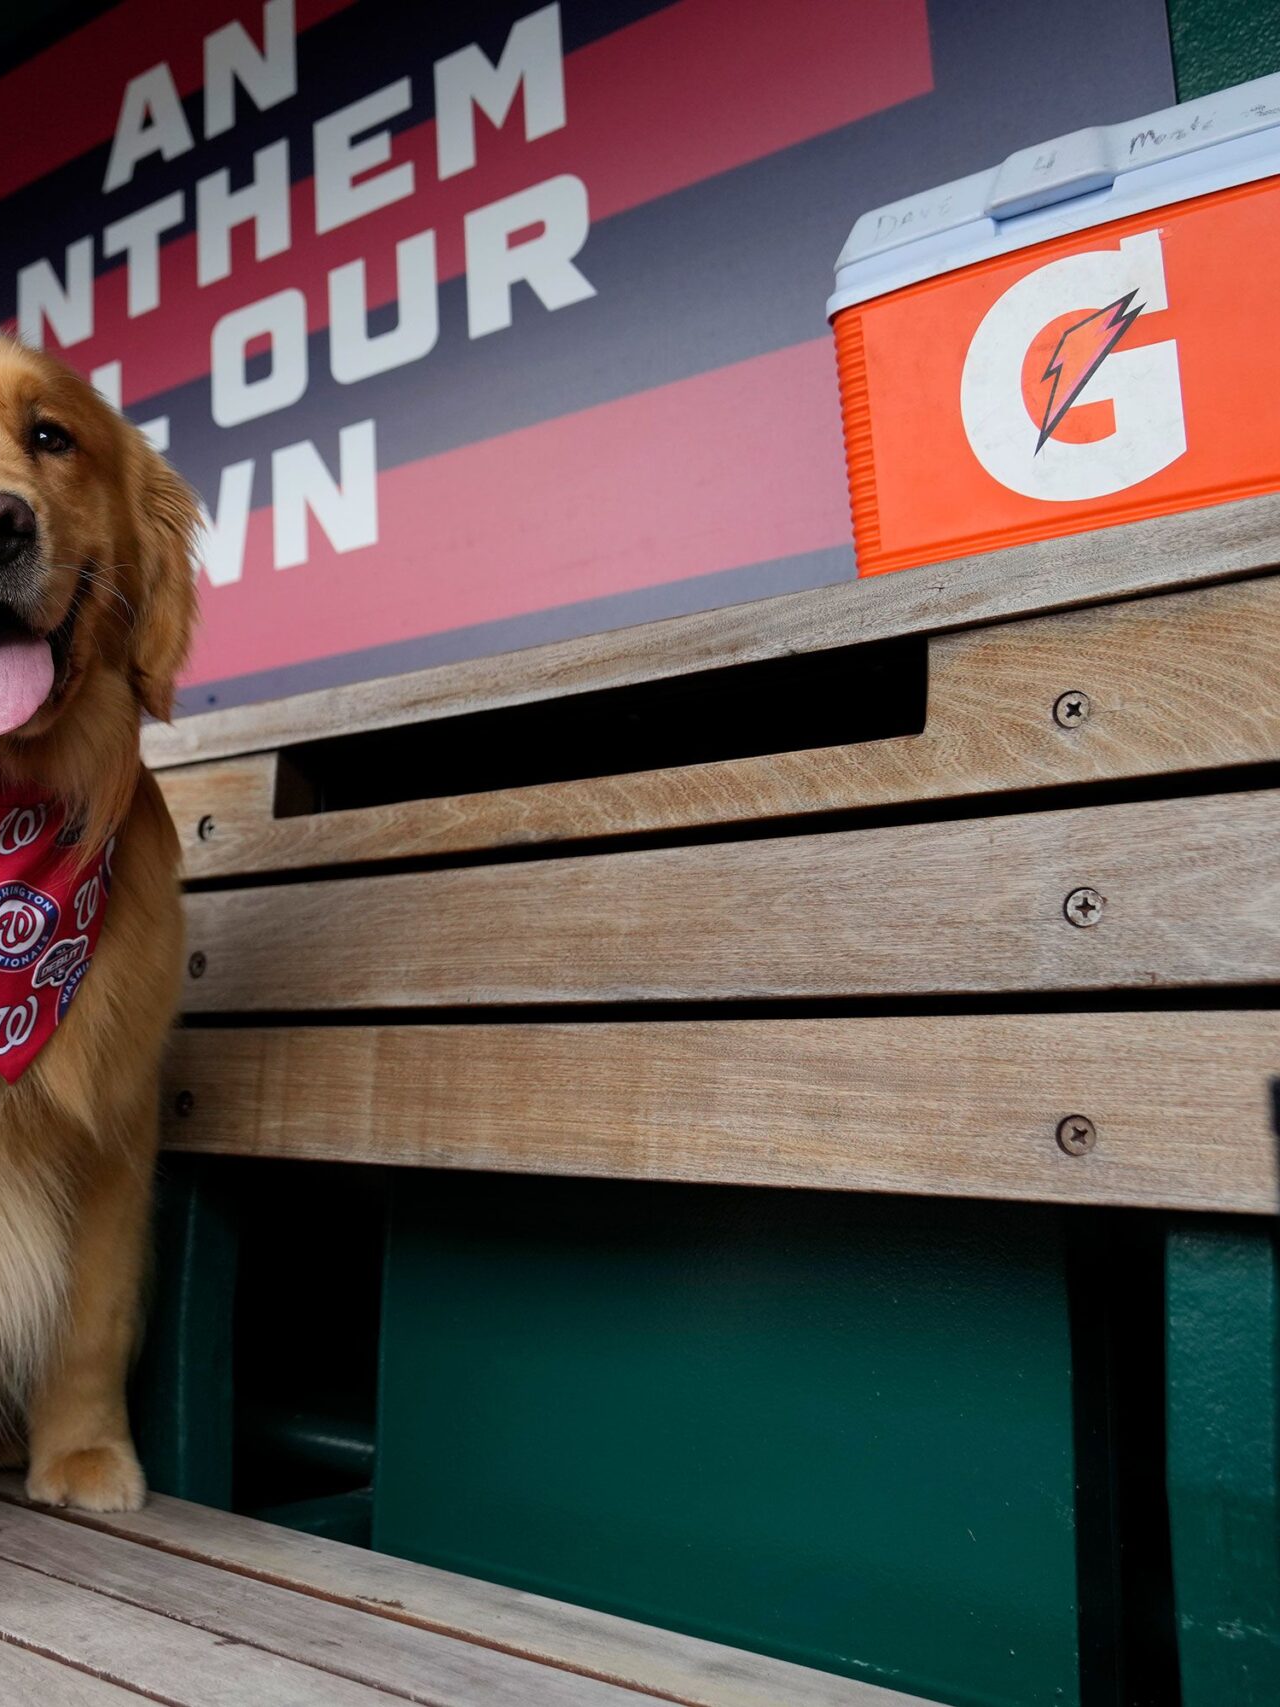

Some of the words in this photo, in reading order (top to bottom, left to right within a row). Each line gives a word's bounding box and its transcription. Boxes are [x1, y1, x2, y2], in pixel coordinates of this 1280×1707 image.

[102, 0, 297, 194] AN
[211, 173, 598, 428] OUR
[960, 228, 1187, 502] G
